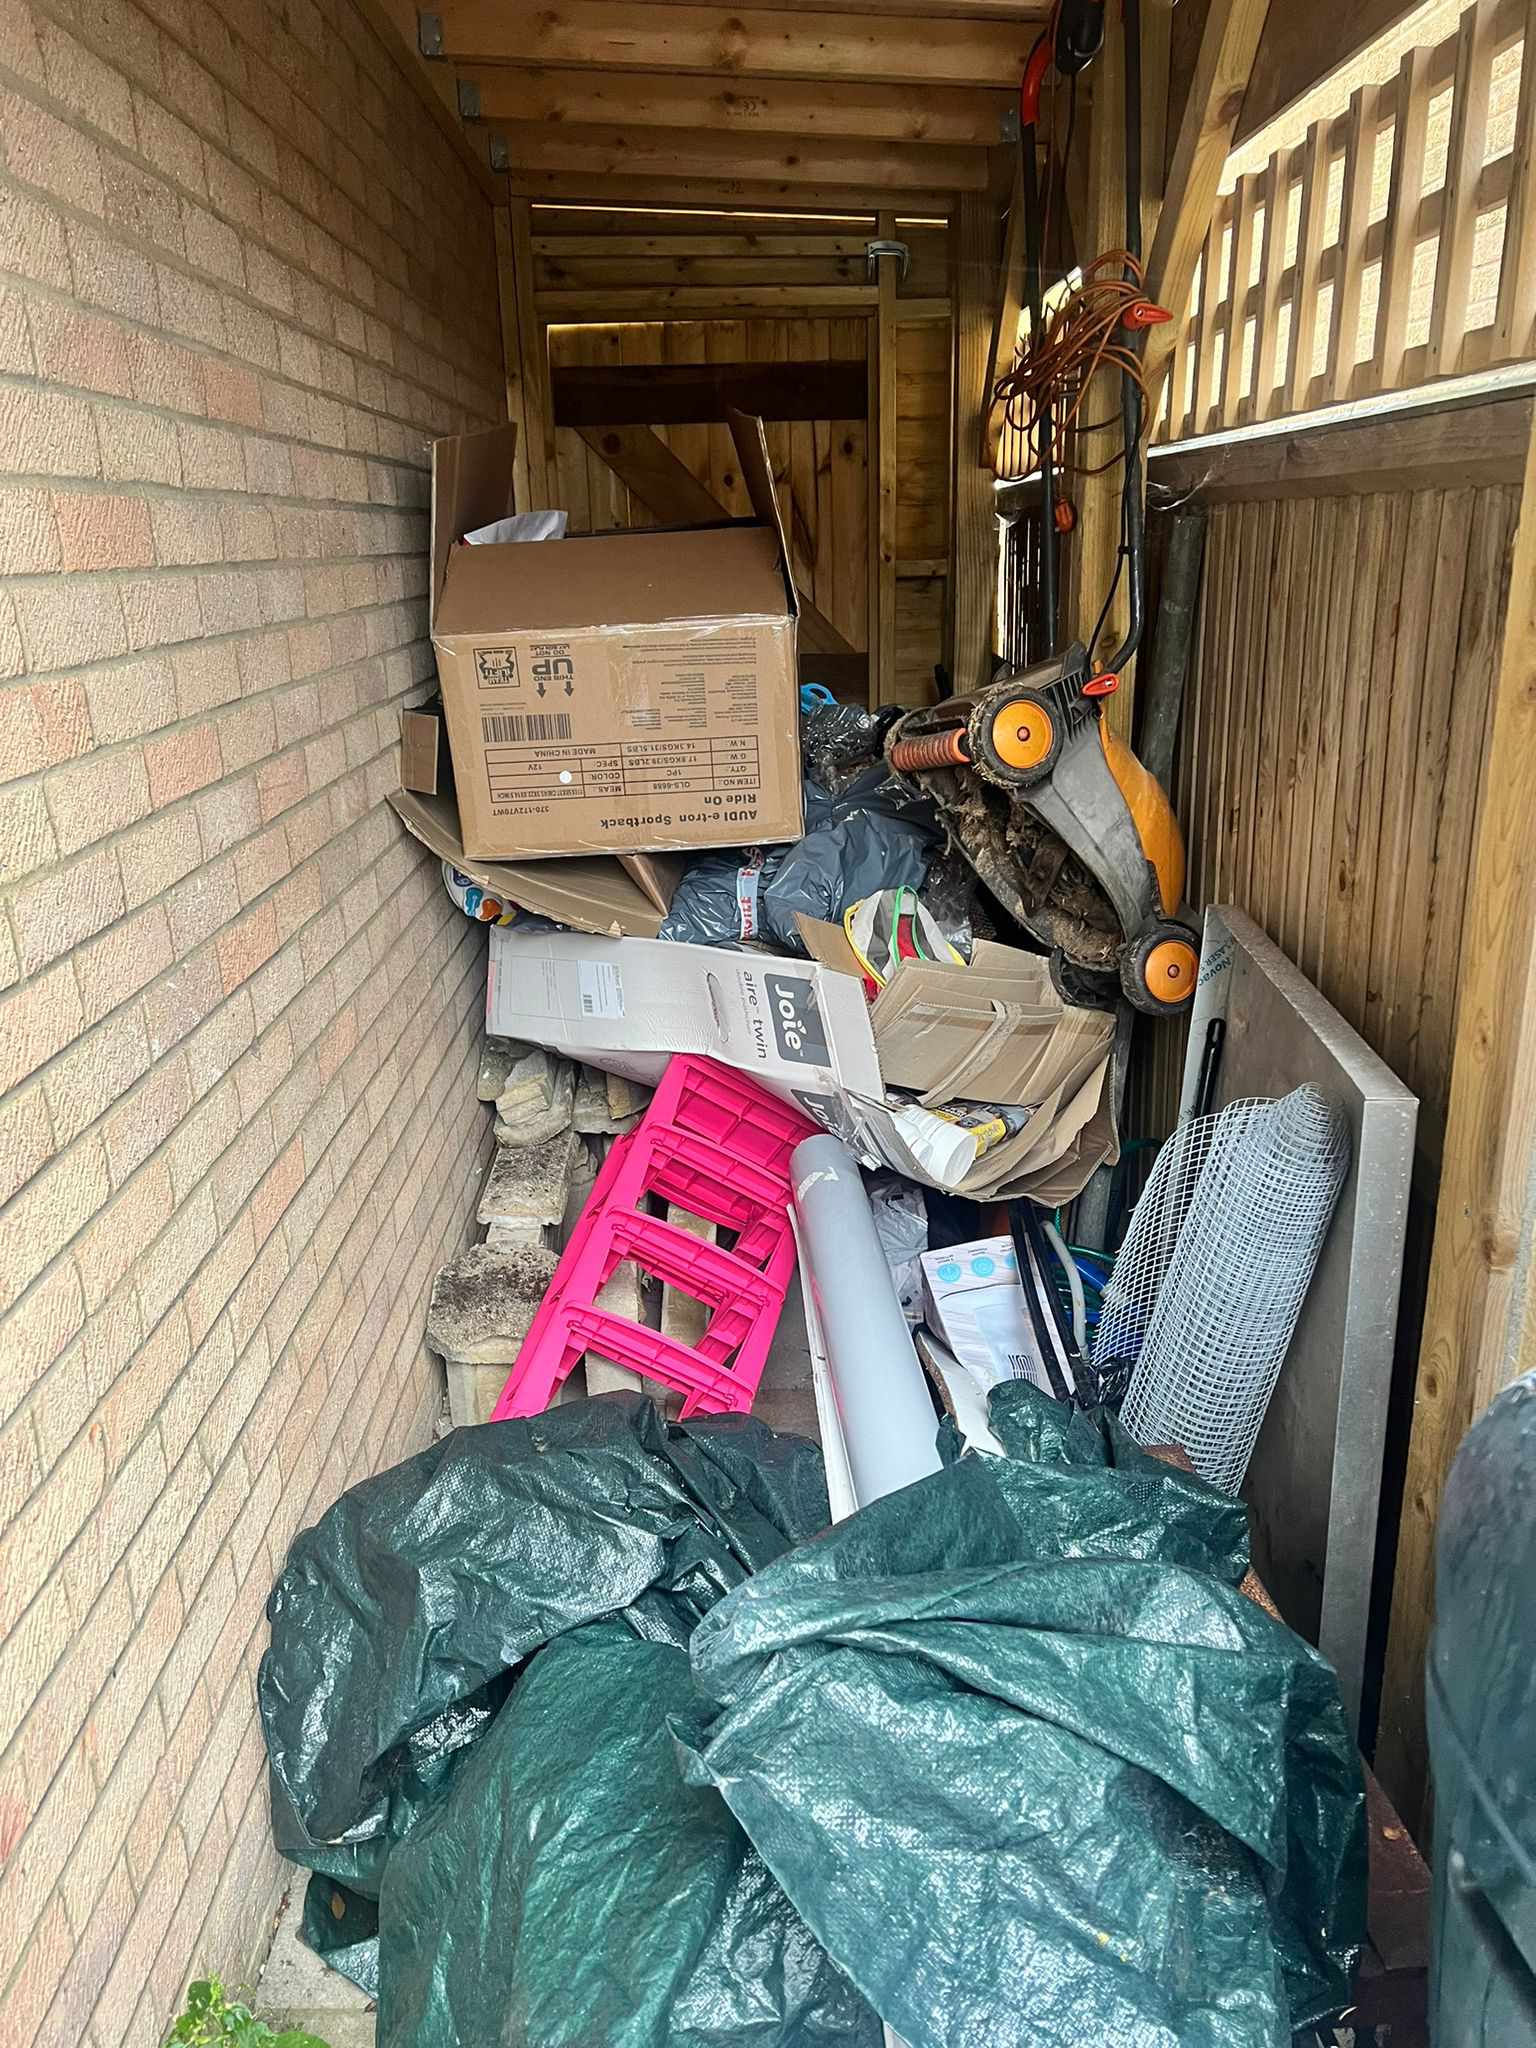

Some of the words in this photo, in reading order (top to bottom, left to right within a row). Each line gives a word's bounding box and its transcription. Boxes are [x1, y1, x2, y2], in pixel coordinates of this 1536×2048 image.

[532, 658, 573, 675] UP
[534, 749, 559, 757] CHINA
[704, 796, 722, 805] On
[726, 794, 756, 804] Ride
[600, 814, 671, 828] Sportback
[679, 812, 720, 823] e-tron
[724, 810, 757, 821] AUDI
[743, 971, 759, 1006] aire
[753, 1019, 768, 1058] twin
[774, 984, 807, 1050] Joie
